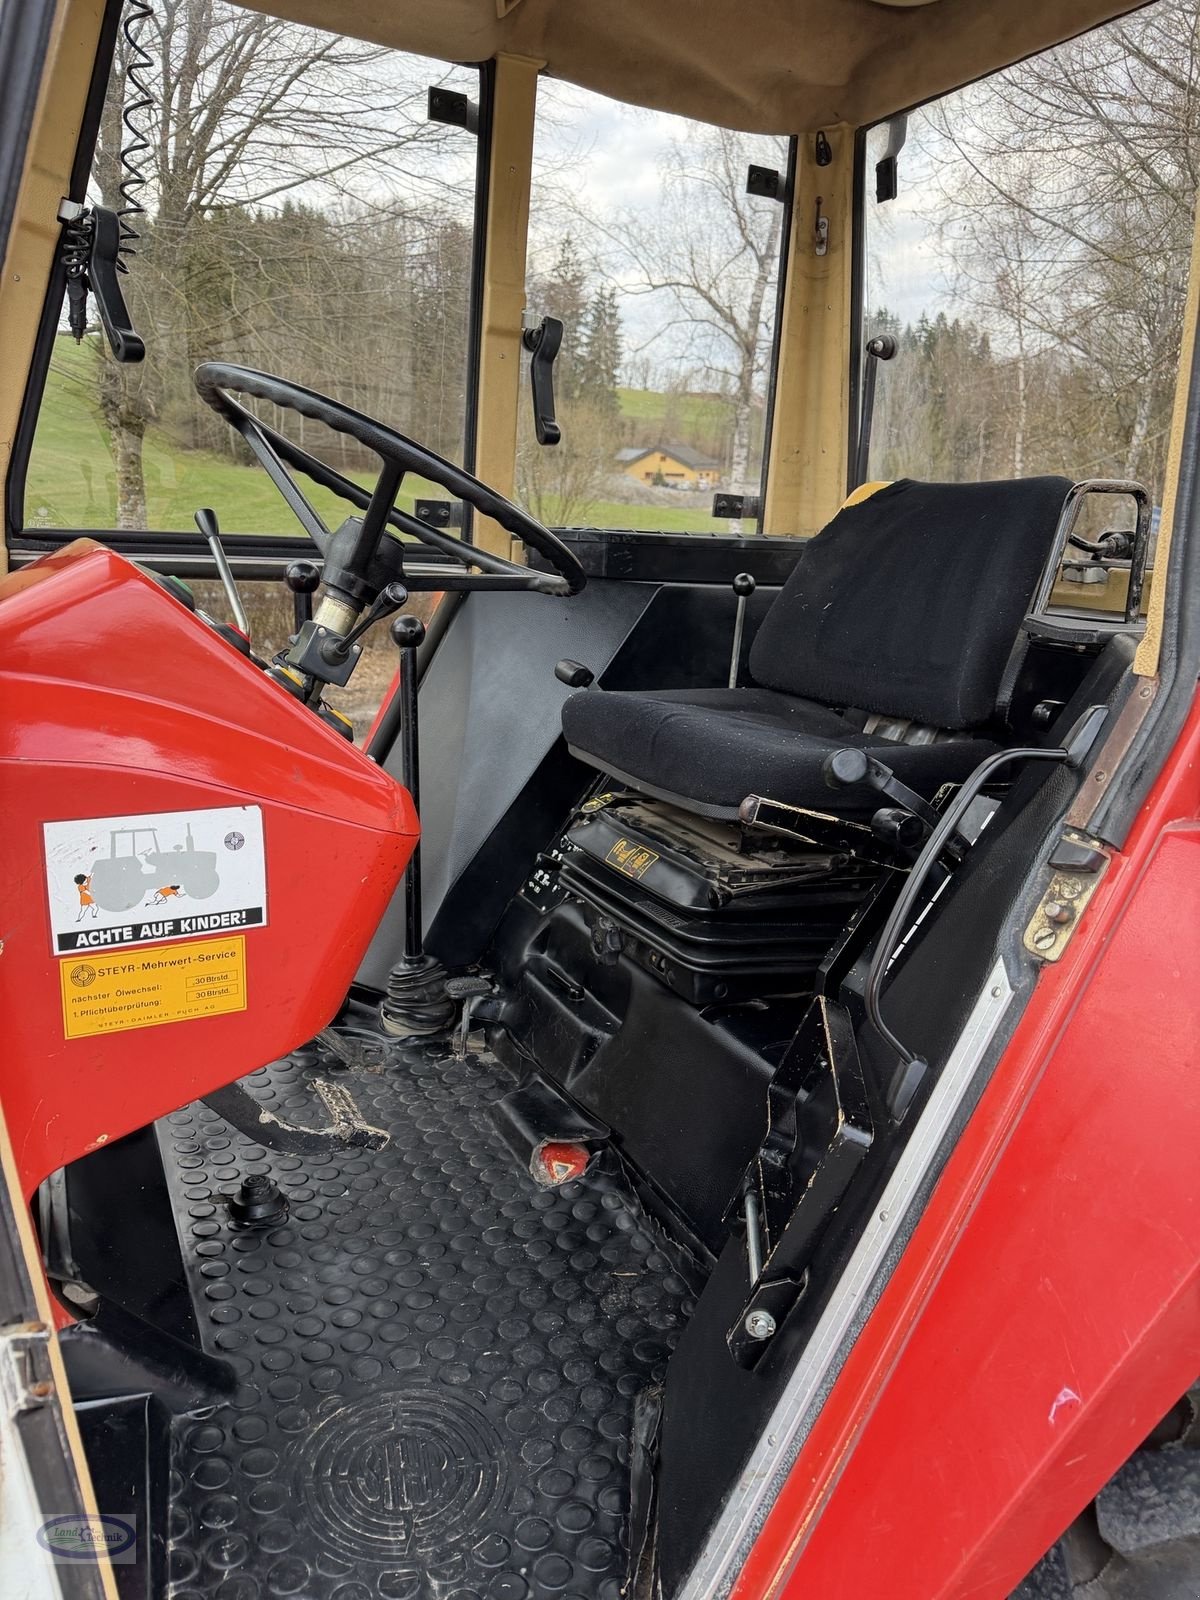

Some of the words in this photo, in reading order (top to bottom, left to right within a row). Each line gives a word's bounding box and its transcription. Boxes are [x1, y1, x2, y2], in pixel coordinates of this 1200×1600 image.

[76, 927, 133, 947] ACHTE
[140, 922, 174, 938] AUF
[180, 911, 247, 932] KINDER!
[195, 977, 206, 985] 30
[71, 992, 111, 1004] nächster
[115, 984, 162, 997] Ölwechsel:
[195, 991, 206, 999] 30
[80, 999, 162, 1017] Pflichtüberprüfung:
